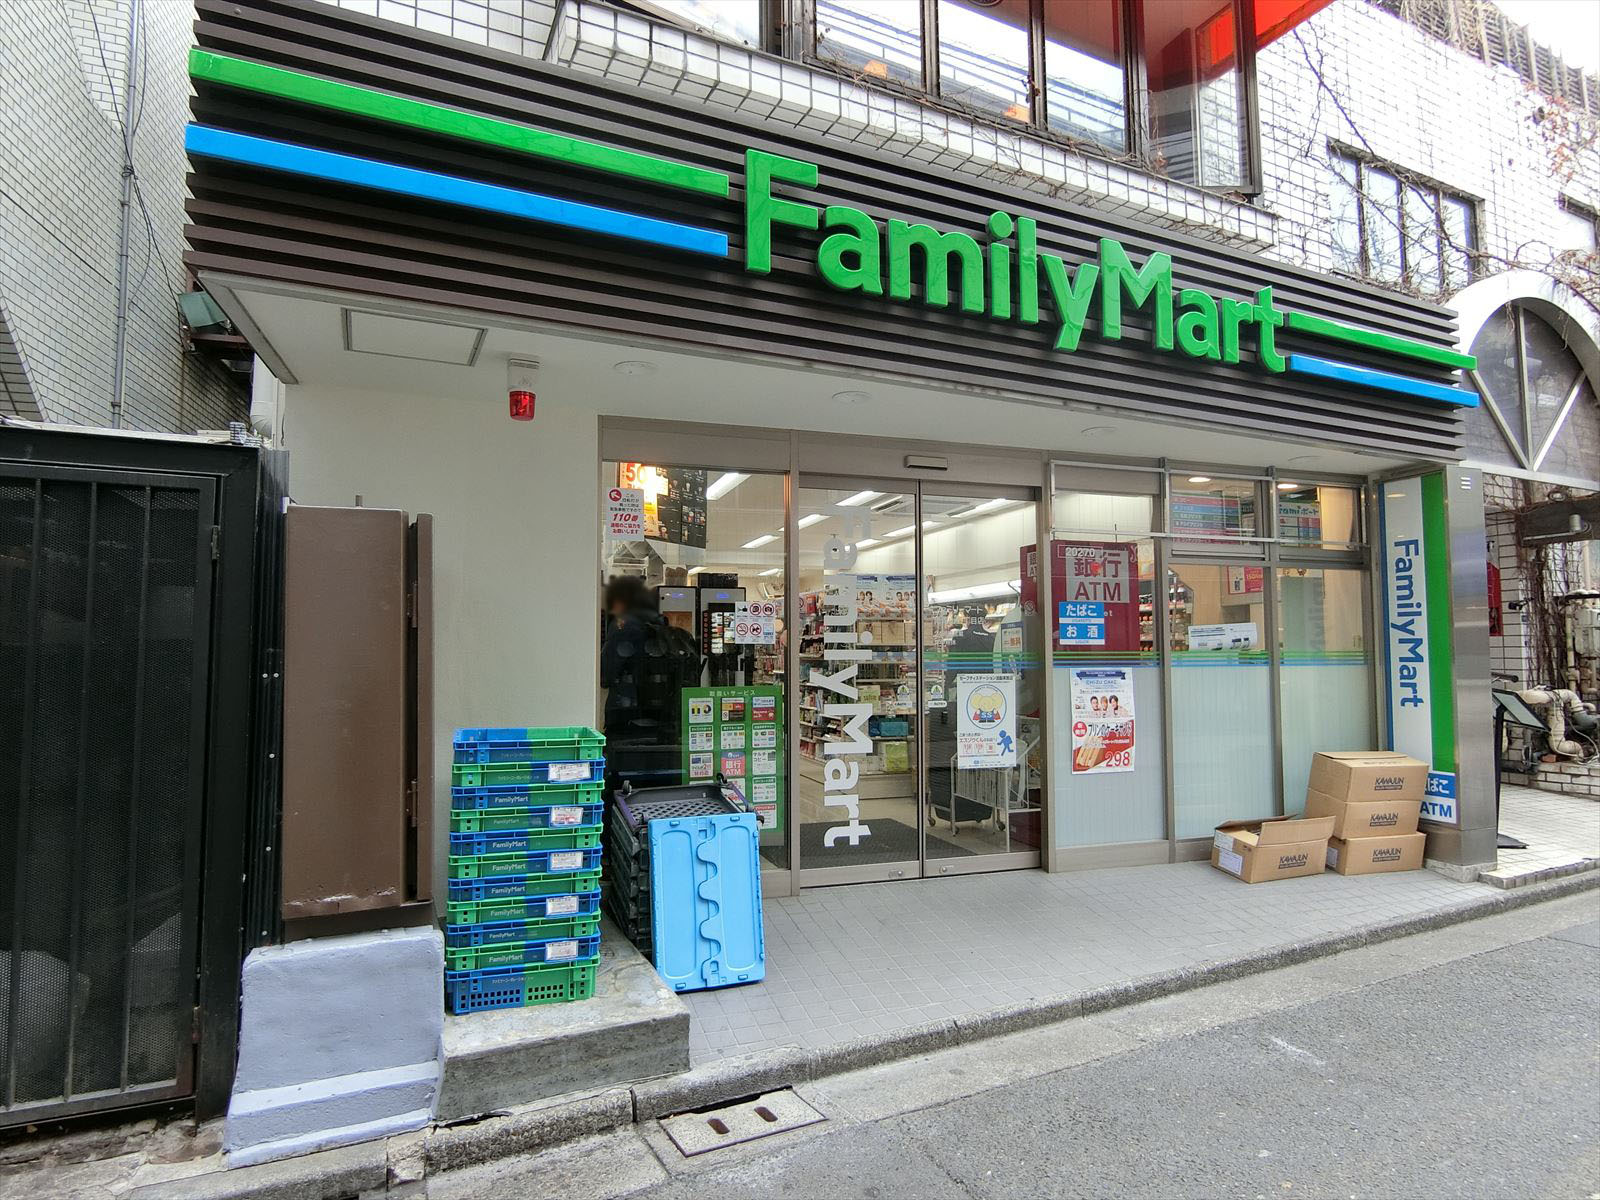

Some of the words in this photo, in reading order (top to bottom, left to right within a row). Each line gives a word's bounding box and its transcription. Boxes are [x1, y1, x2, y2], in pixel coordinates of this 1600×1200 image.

[744, 148, 1286, 374] FamilyMart
[1065, 546, 1096, 558] 20270
[1074, 551, 1122, 578] 銀行
[1074, 581, 1121, 602] ATM
[1066, 603, 1098, 617] たばこ
[1390, 538, 1425, 708] FamilyMart
[1066, 624, 1099, 638] お酒
[809, 505, 873, 847] FamilyMart
[1104, 750, 1131, 768] 298
[725, 768, 742, 776] ATM
[1375, 777, 1404, 785] KAWAJUN
[1424, 777, 1450, 794] ばこ
[494, 796, 529, 804] FamilyMart
[1419, 801, 1452, 818] ATM
[1370, 812, 1398, 821] KAWAJUN
[492, 841, 527, 849] FamilyMart
[1373, 848, 1401, 857] KAWAJUN
[1279, 853, 1309, 864] KAWAJUN
[492, 863, 526, 872] FamilyMart
[491, 886, 526, 894] FamilyMart
[490, 908, 525, 917] FamilyMart
[489, 931, 516, 939] FamilyMart
[488, 953, 523, 963] FamilyMart
